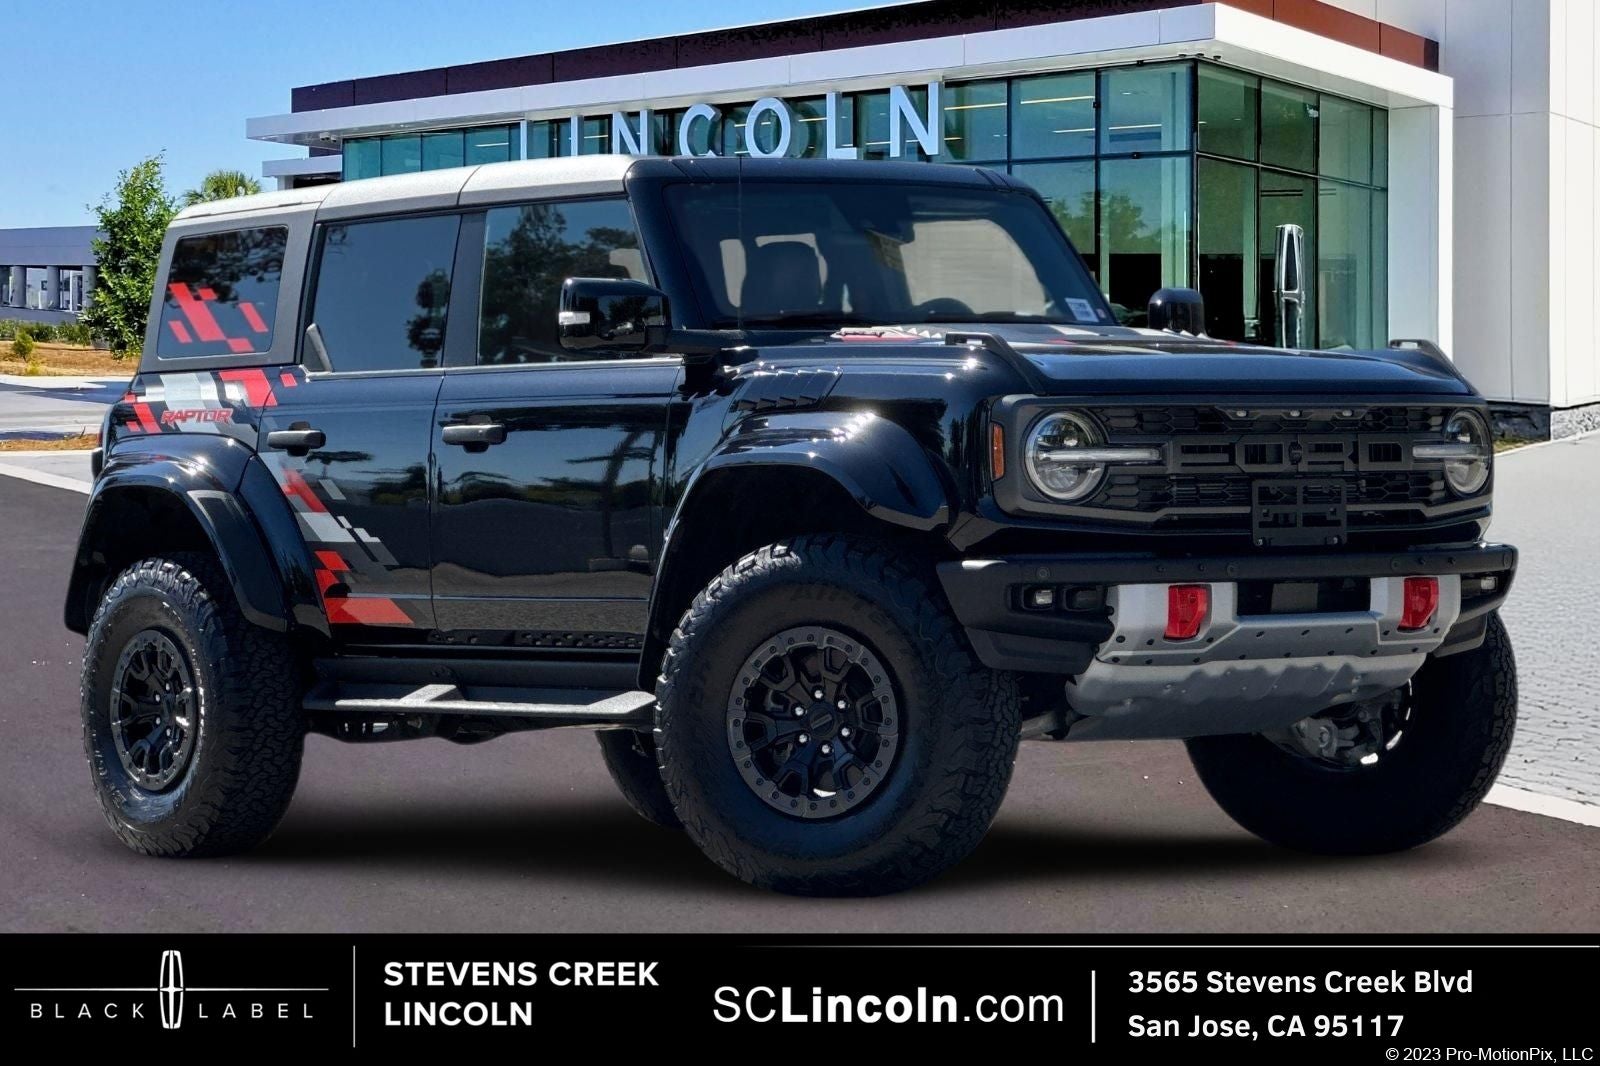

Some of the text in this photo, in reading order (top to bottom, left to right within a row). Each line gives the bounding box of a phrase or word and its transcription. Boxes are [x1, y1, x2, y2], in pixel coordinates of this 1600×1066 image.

[520, 80, 942, 161] LINCOLN
[161, 408, 234, 424] RAPTOR
[1167, 433, 1411, 474] FORD
